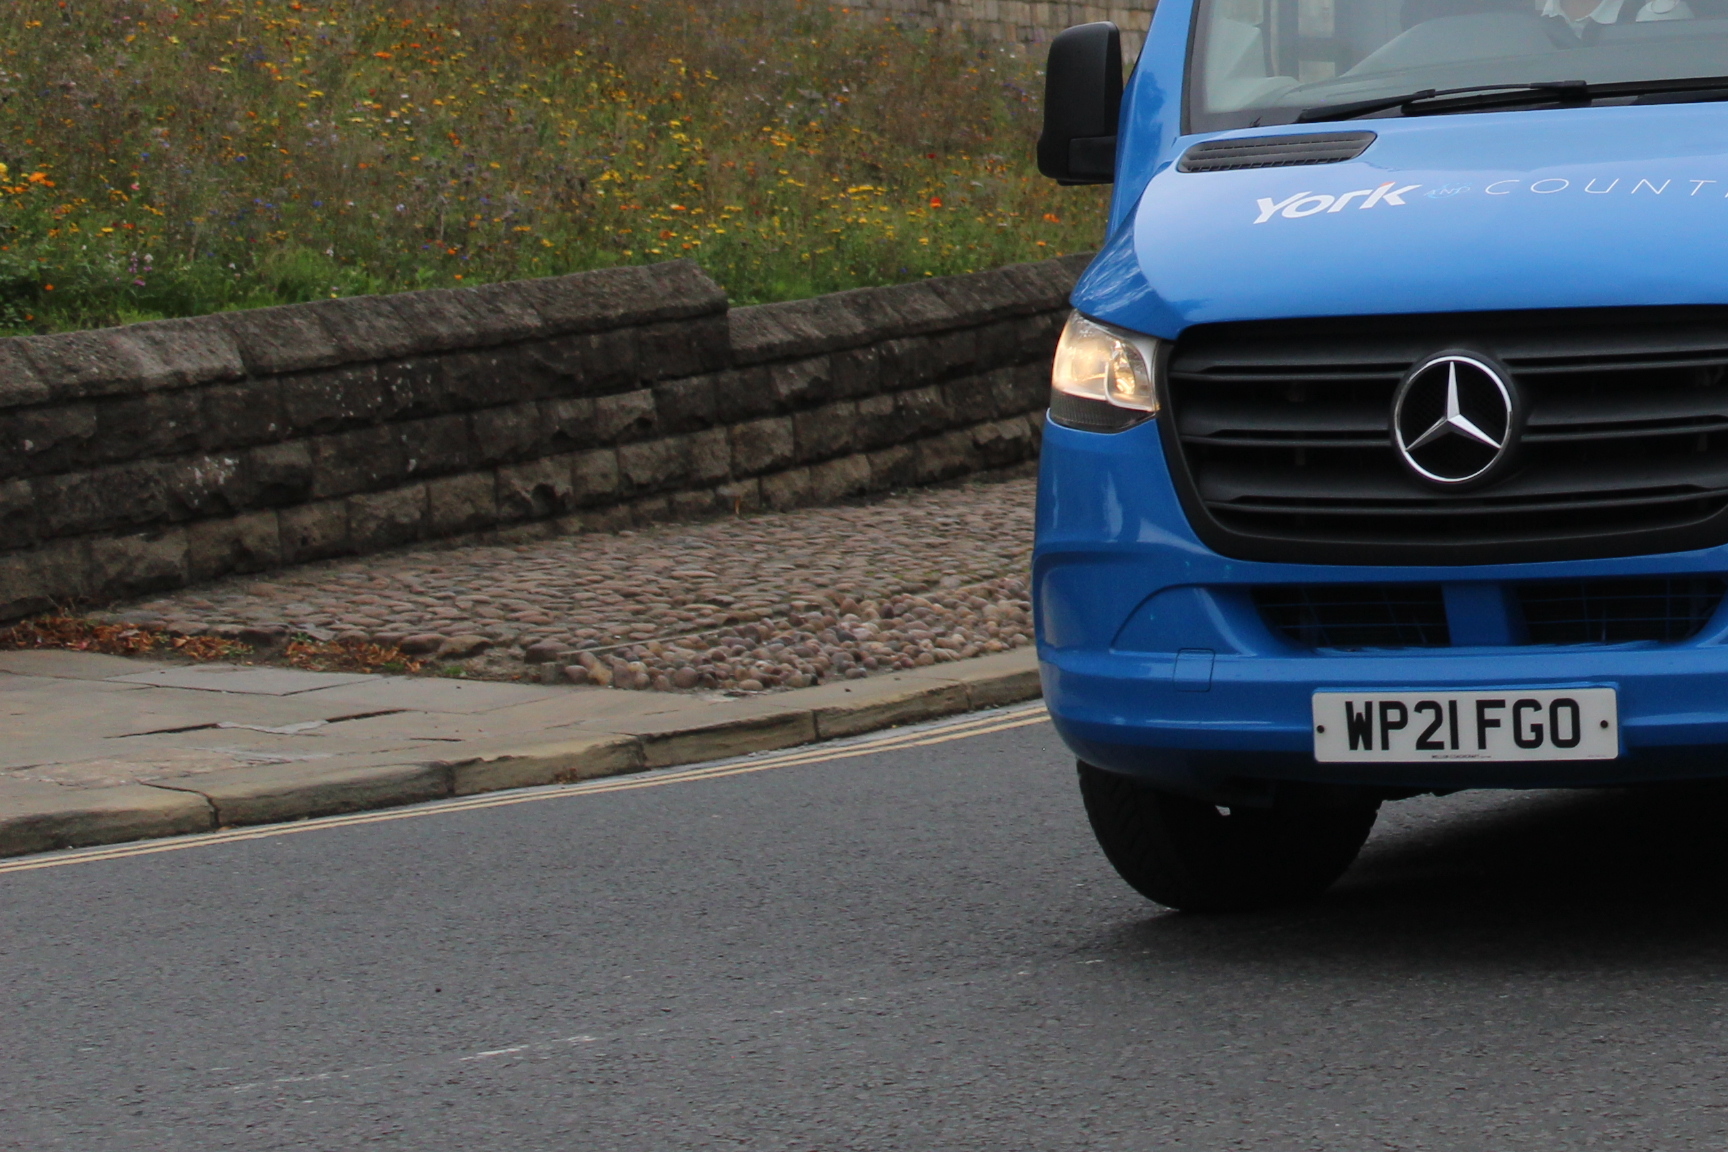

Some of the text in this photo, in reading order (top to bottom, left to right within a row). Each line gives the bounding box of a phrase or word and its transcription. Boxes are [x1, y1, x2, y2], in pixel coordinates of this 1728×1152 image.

[1251, 181, 1423, 225] York
[1345, 697, 1581, 751] WP21 FGO
